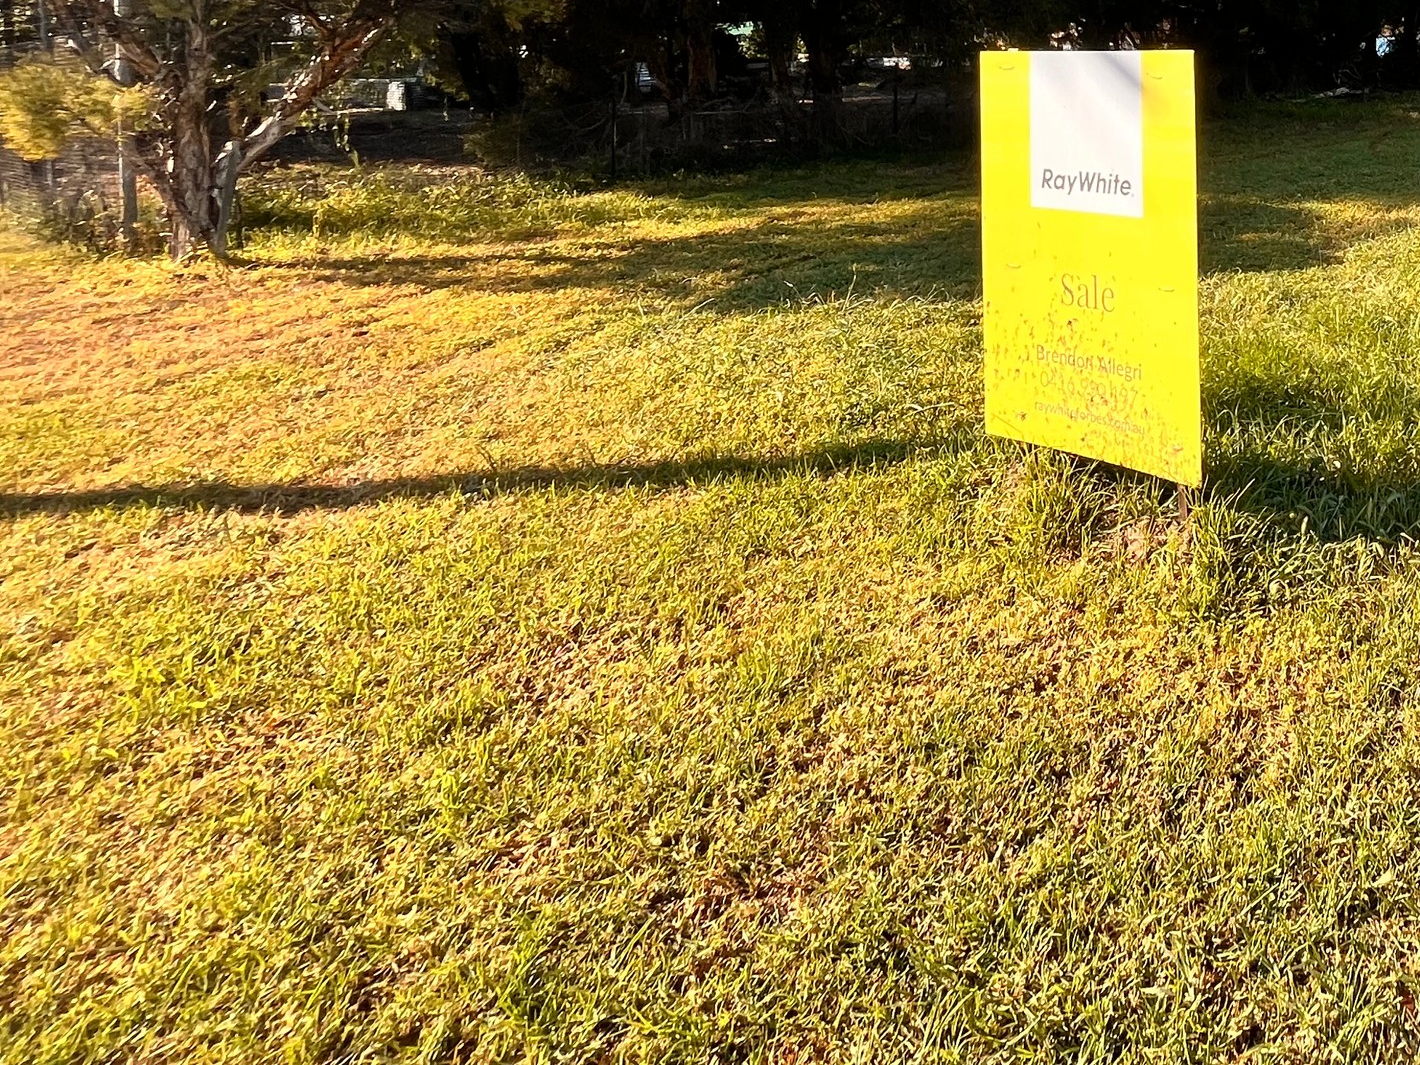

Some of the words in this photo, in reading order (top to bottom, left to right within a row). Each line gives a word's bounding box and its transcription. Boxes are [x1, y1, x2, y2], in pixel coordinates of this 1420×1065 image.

[1061, 272, 1115, 313] Sale
[1036, 344, 1093, 370] Brendon
[1097, 355, 1142, 382] Allegri
